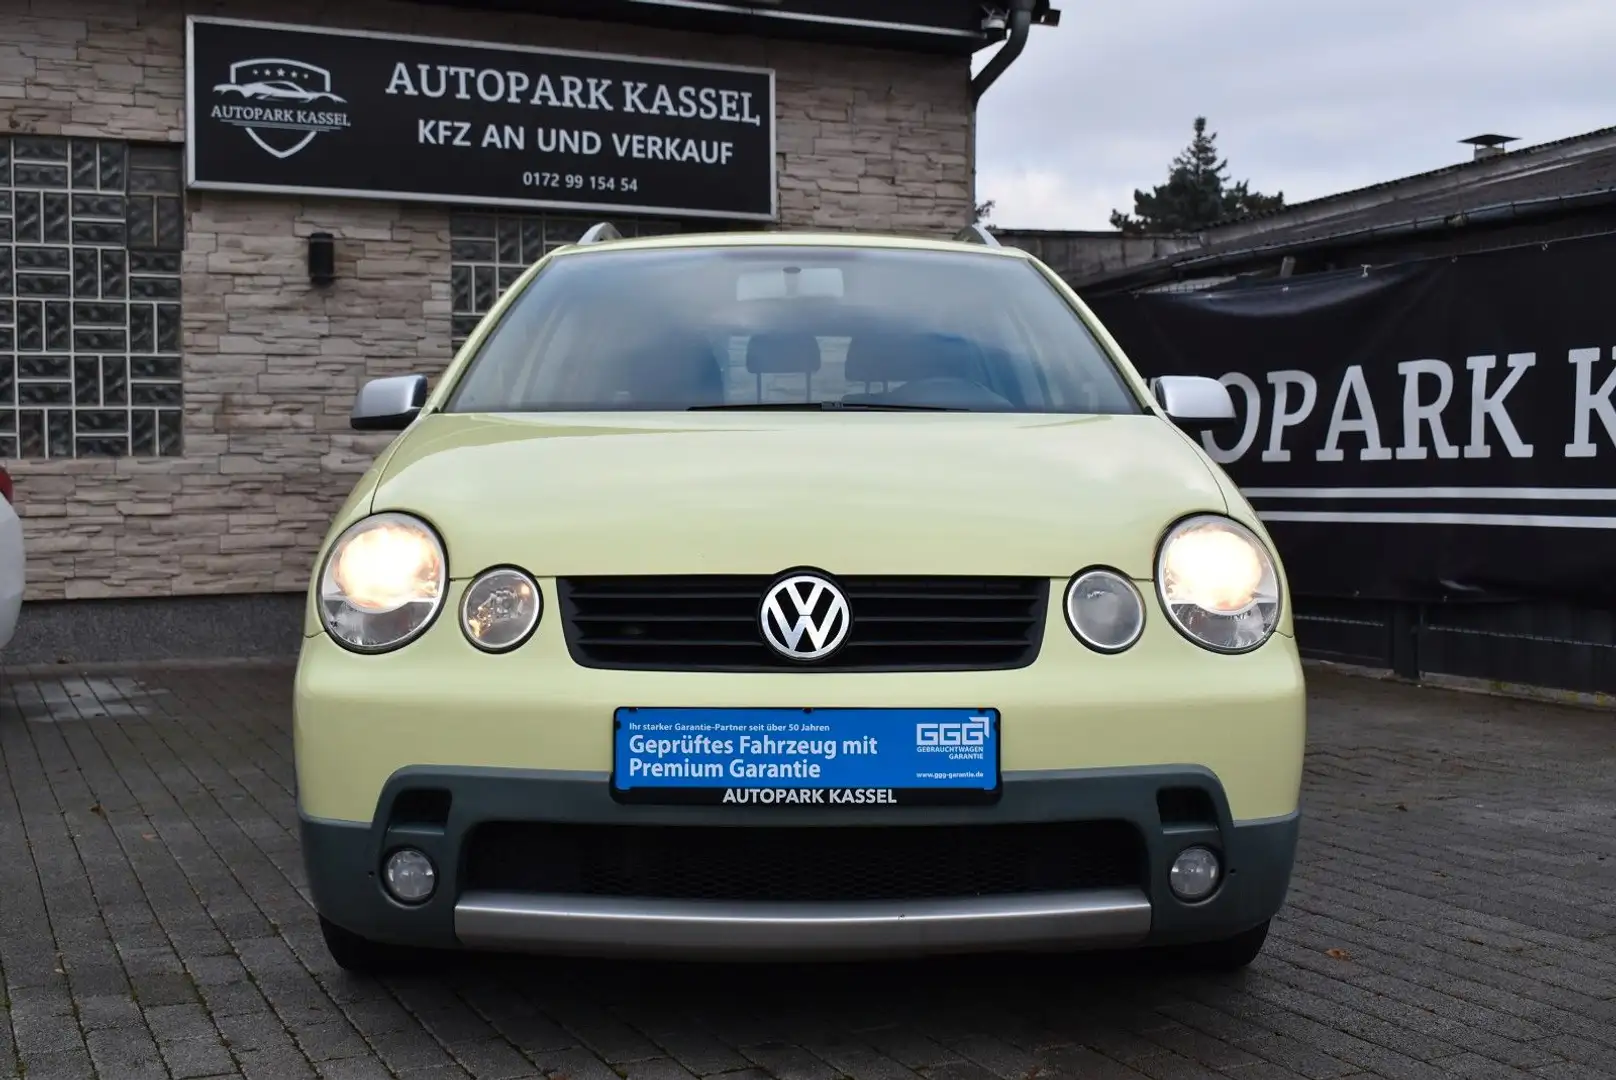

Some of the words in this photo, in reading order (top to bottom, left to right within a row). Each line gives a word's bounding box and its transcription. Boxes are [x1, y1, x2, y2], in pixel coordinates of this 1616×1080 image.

[385, 62, 613, 113] AUTOPARK
[622, 80, 761, 127] KASSEL
[211, 105, 293, 122] AUTOPARK
[296, 110, 351, 127] KASSEL
[418, 119, 472, 147] KFZ
[481, 123, 525, 149] AN
[537, 127, 602, 155] UND
[612, 133, 734, 165] VERKAUF
[522, 171, 559, 187] 0172
[565, 173, 583, 189] 99
[590, 175, 614, 191] 154
[621, 177, 638, 192] 54
[1143, 352, 1537, 463] OPARK
[629, 722, 640, 731] Ihr
[642, 722, 672, 731] starker
[674, 722, 747, 731] Garantie-Partner
[749, 723, 765, 732] seit
[767, 723, 787, 732] über
[788, 723, 799, 732] 50
[801, 723, 830, 732] Jahren
[917, 722, 985, 746] GGG
[629, 735, 734, 758] Geprüftes
[739, 735, 837, 759] Fahrzeug
[843, 736, 878, 755] mit
[629, 758, 724, 778] Premium
[729, 759, 821, 778] Garantie
[916, 771, 984, 780] www.ggg-garantie.de
[722, 788, 825, 804] AUTOPARK
[829, 788, 897, 804] KASSEL
